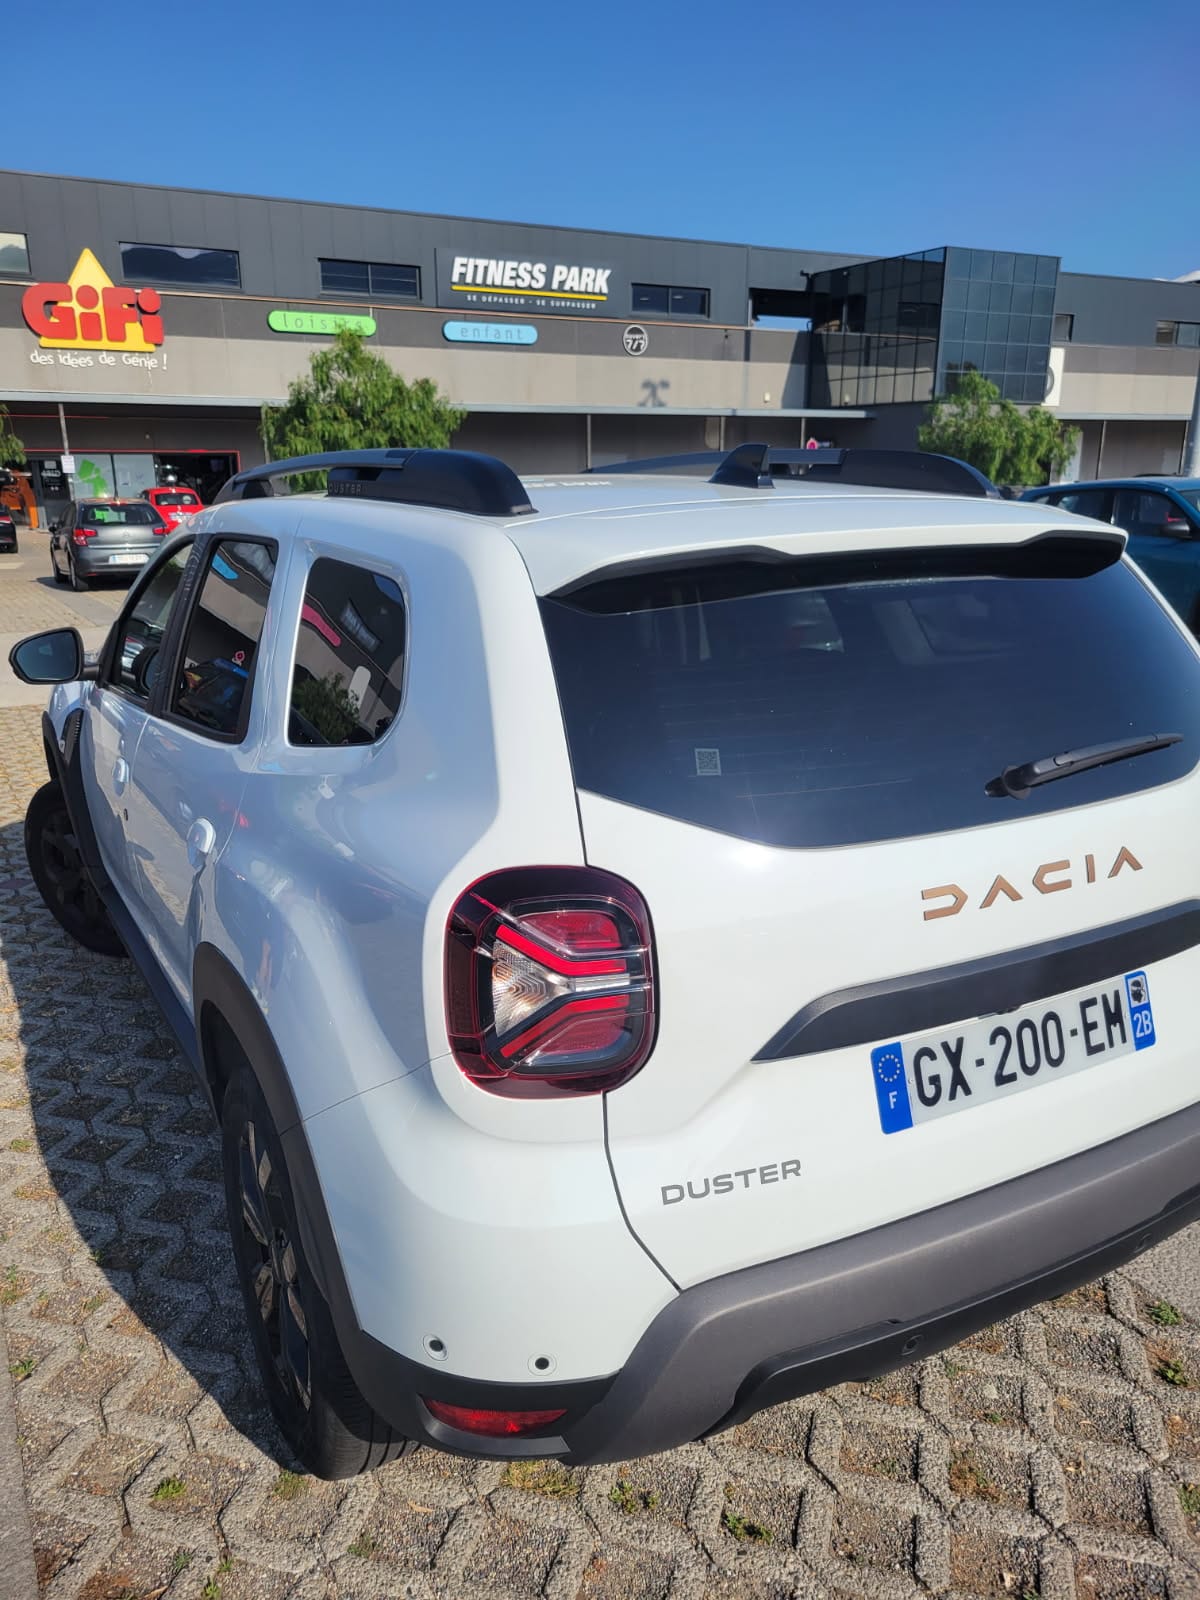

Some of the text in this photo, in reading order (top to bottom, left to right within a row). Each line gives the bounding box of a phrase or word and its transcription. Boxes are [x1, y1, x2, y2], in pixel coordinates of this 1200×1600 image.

[452, 256, 611, 294] FITNESS PARK
[460, 324, 525, 340] enfant
[30, 350, 54, 365] des
[58, 350, 94, 367] idées
[99, 351, 116, 366] de
[921, 846, 1143, 921] DACIA
[888, 989, 1153, 1109] F GX-200-EM 2B
[661, 1159, 801, 1205] DUSTER
